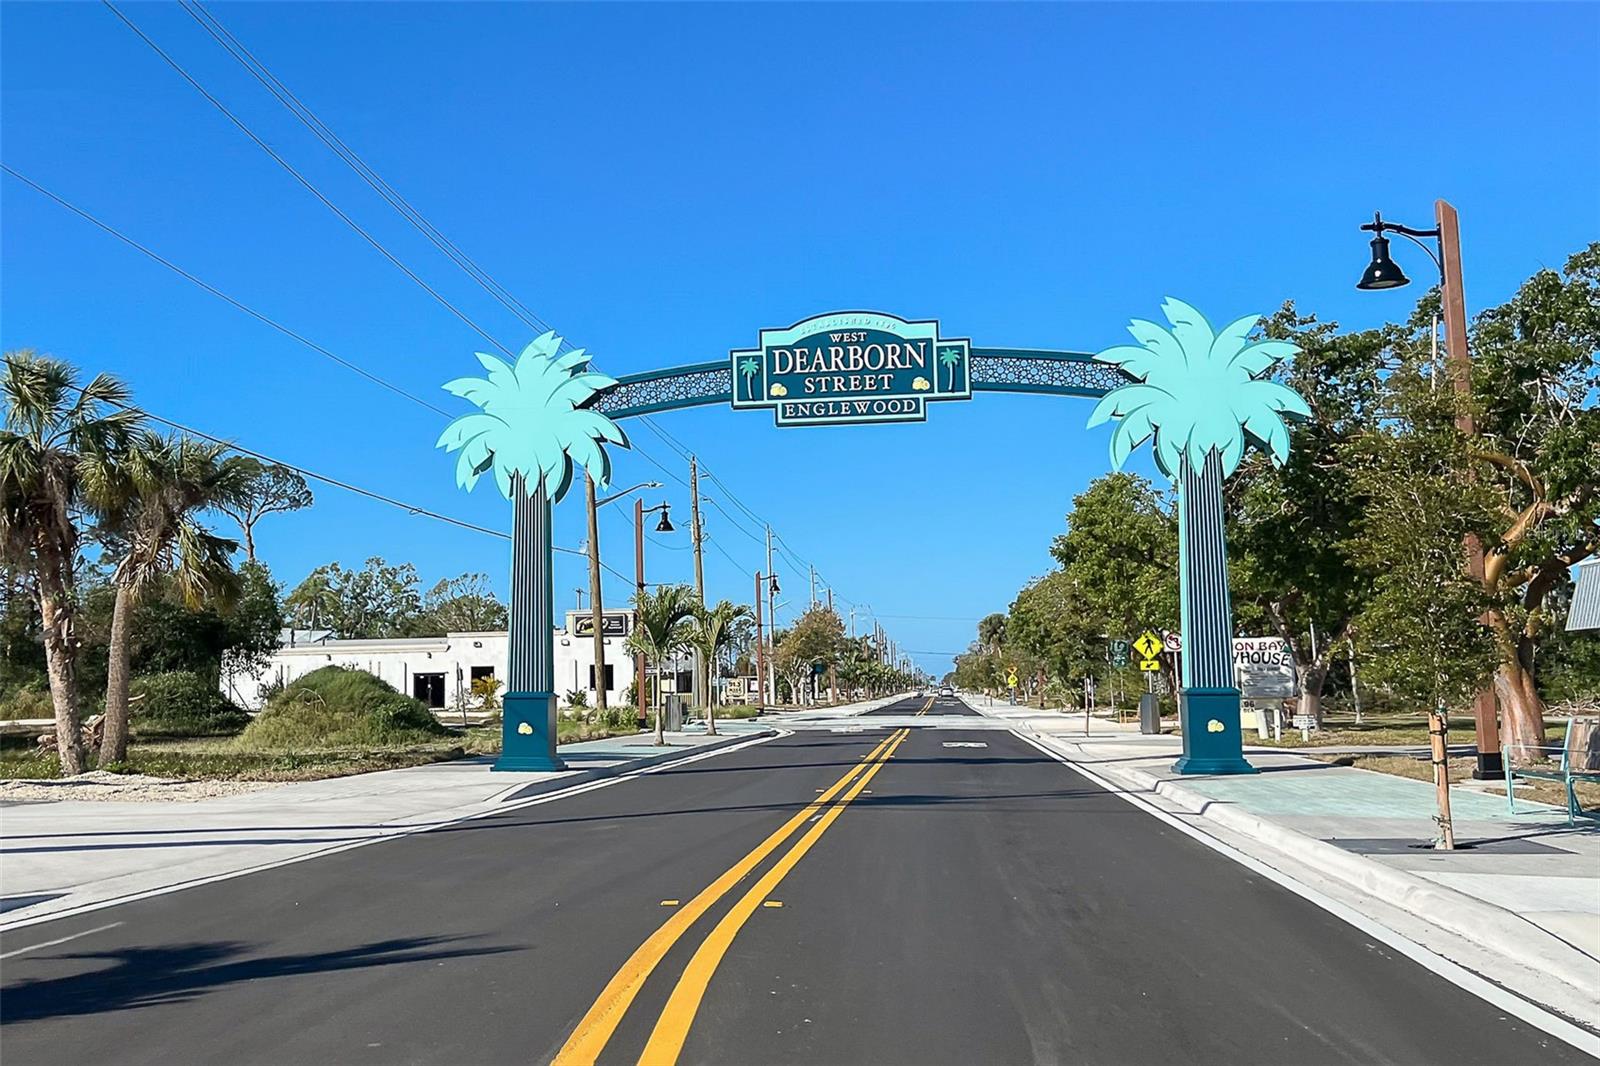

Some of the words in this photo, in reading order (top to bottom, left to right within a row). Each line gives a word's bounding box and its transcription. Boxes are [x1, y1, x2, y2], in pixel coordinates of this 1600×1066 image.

[830, 332, 867, 343] WEST
[772, 342, 926, 375] DEARBORN
[804, 374, 894, 393] STREET
[785, 400, 916, 416] ENGLEWOOD
[1234, 642, 1254, 651] ON
[1258, 642, 1286, 651] BAY
[1232, 652, 1291, 666] YHOUSE
